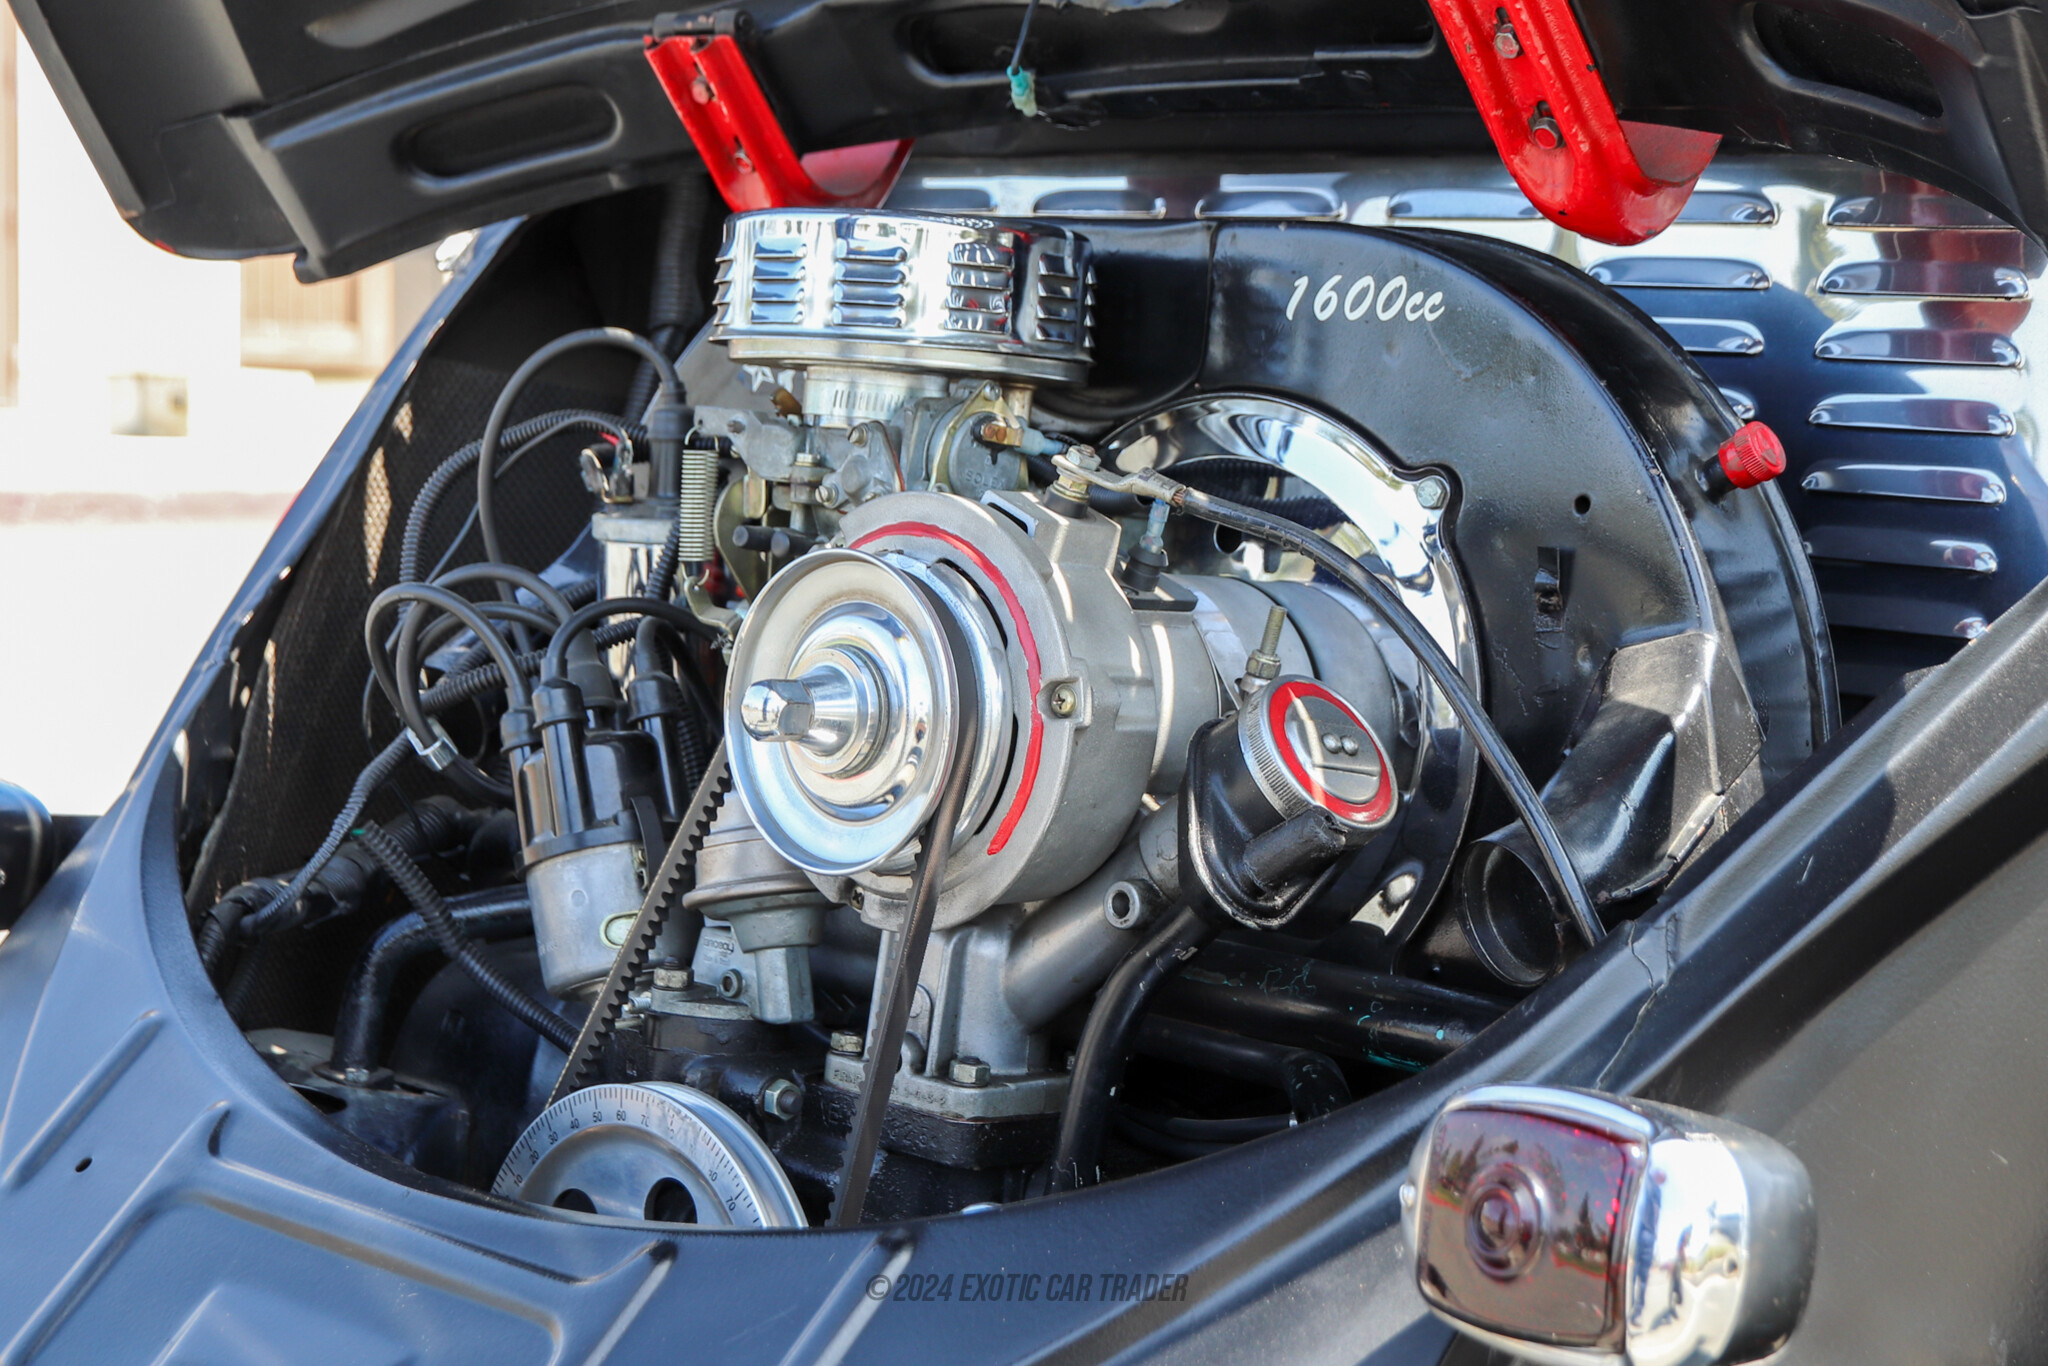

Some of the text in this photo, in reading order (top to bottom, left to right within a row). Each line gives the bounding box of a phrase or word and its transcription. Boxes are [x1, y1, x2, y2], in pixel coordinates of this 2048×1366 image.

[1285, 274, 1446, 322] 1600cc
[513, 1174, 523, 1187] 10
[529, 1150, 540, 1165] 20
[548, 1131, 559, 1145] 30
[570, 1118, 580, 1130] 40
[592, 1111, 603, 1123] 50
[616, 1110, 627, 1122] 60
[726, 1196, 737, 1212] 70
